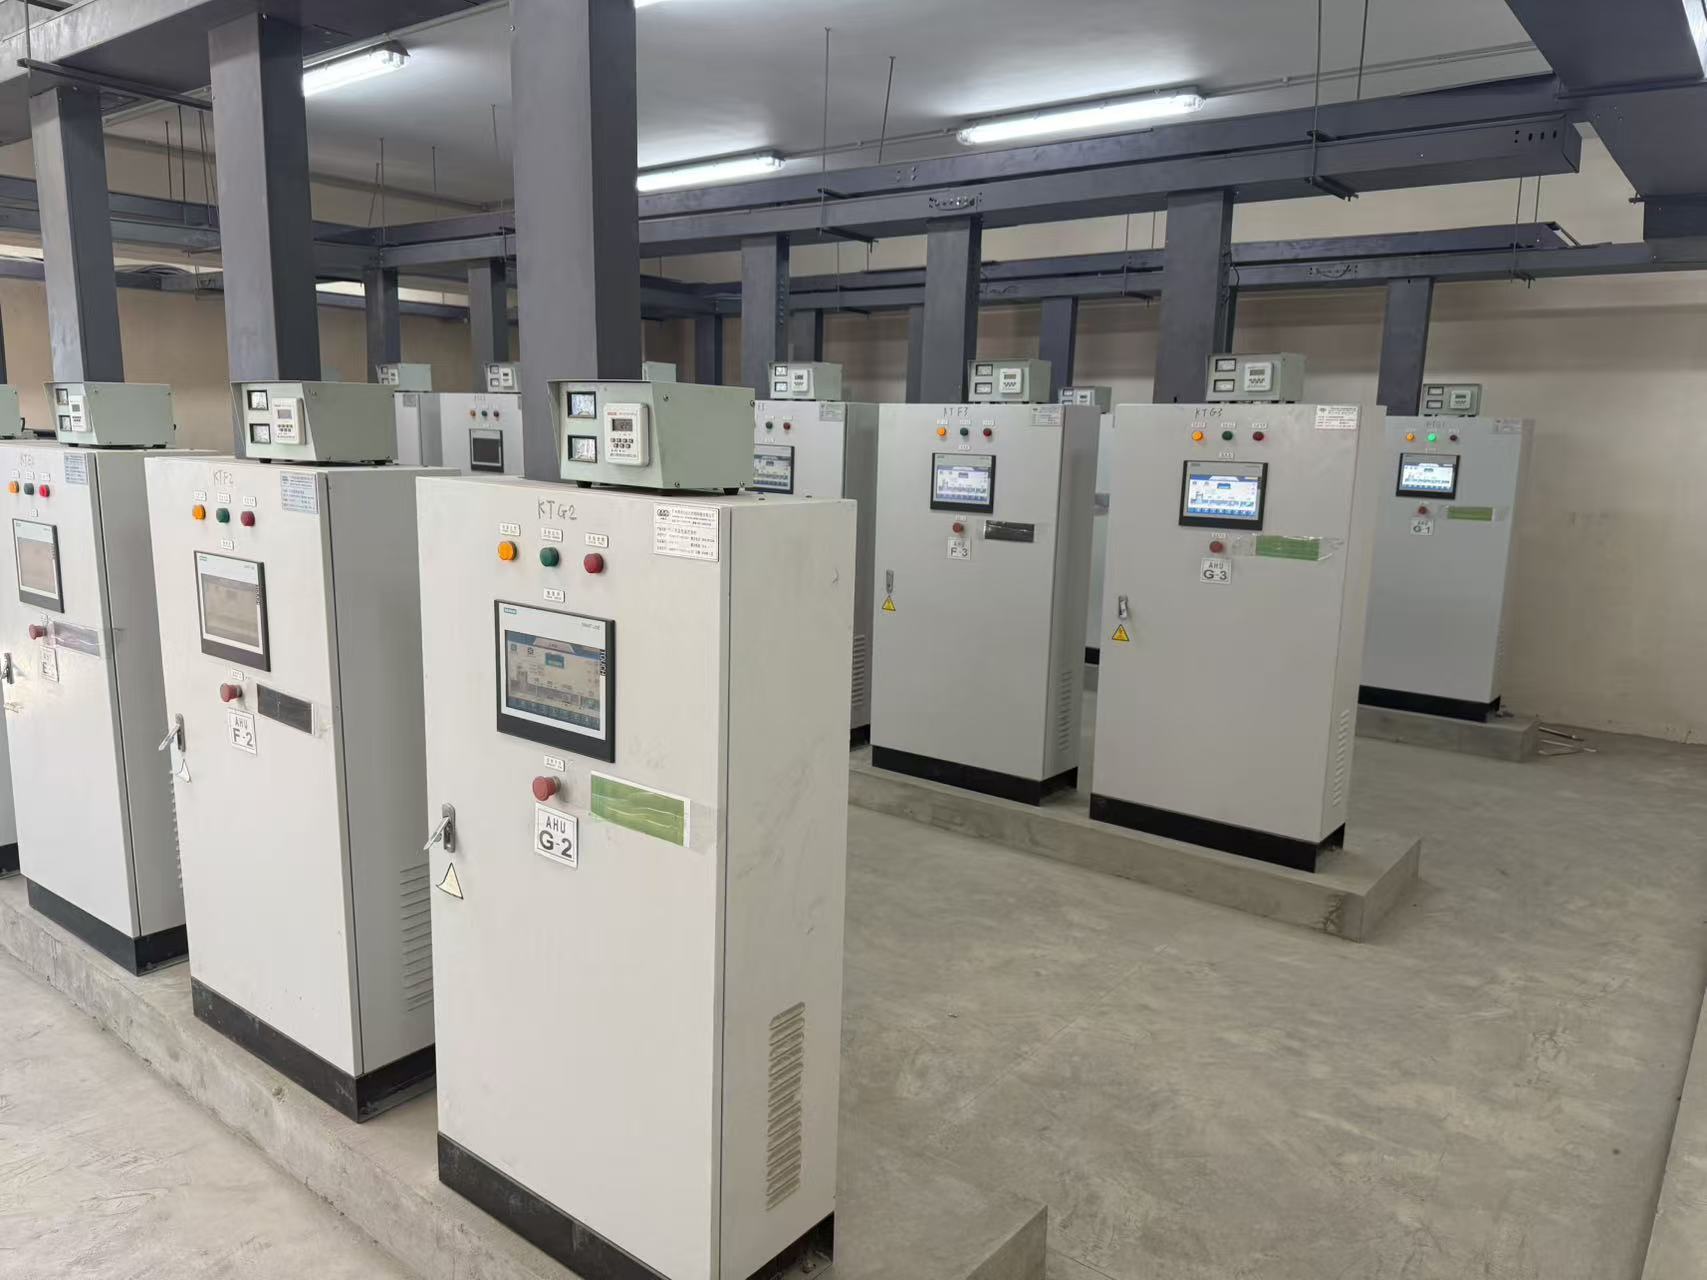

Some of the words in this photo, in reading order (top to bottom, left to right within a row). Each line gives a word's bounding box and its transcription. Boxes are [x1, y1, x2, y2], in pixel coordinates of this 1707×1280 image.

[537, 498, 578, 521] KTG2
[950, 547, 968, 557] F-3
[1208, 560, 1224, 570] AHU
[1203, 569, 1227, 581] G-3
[234, 715, 249, 731] AHU
[232, 727, 254, 748] F-2
[545, 815, 567, 834] AHU
[539, 829, 573, 859] G-2
